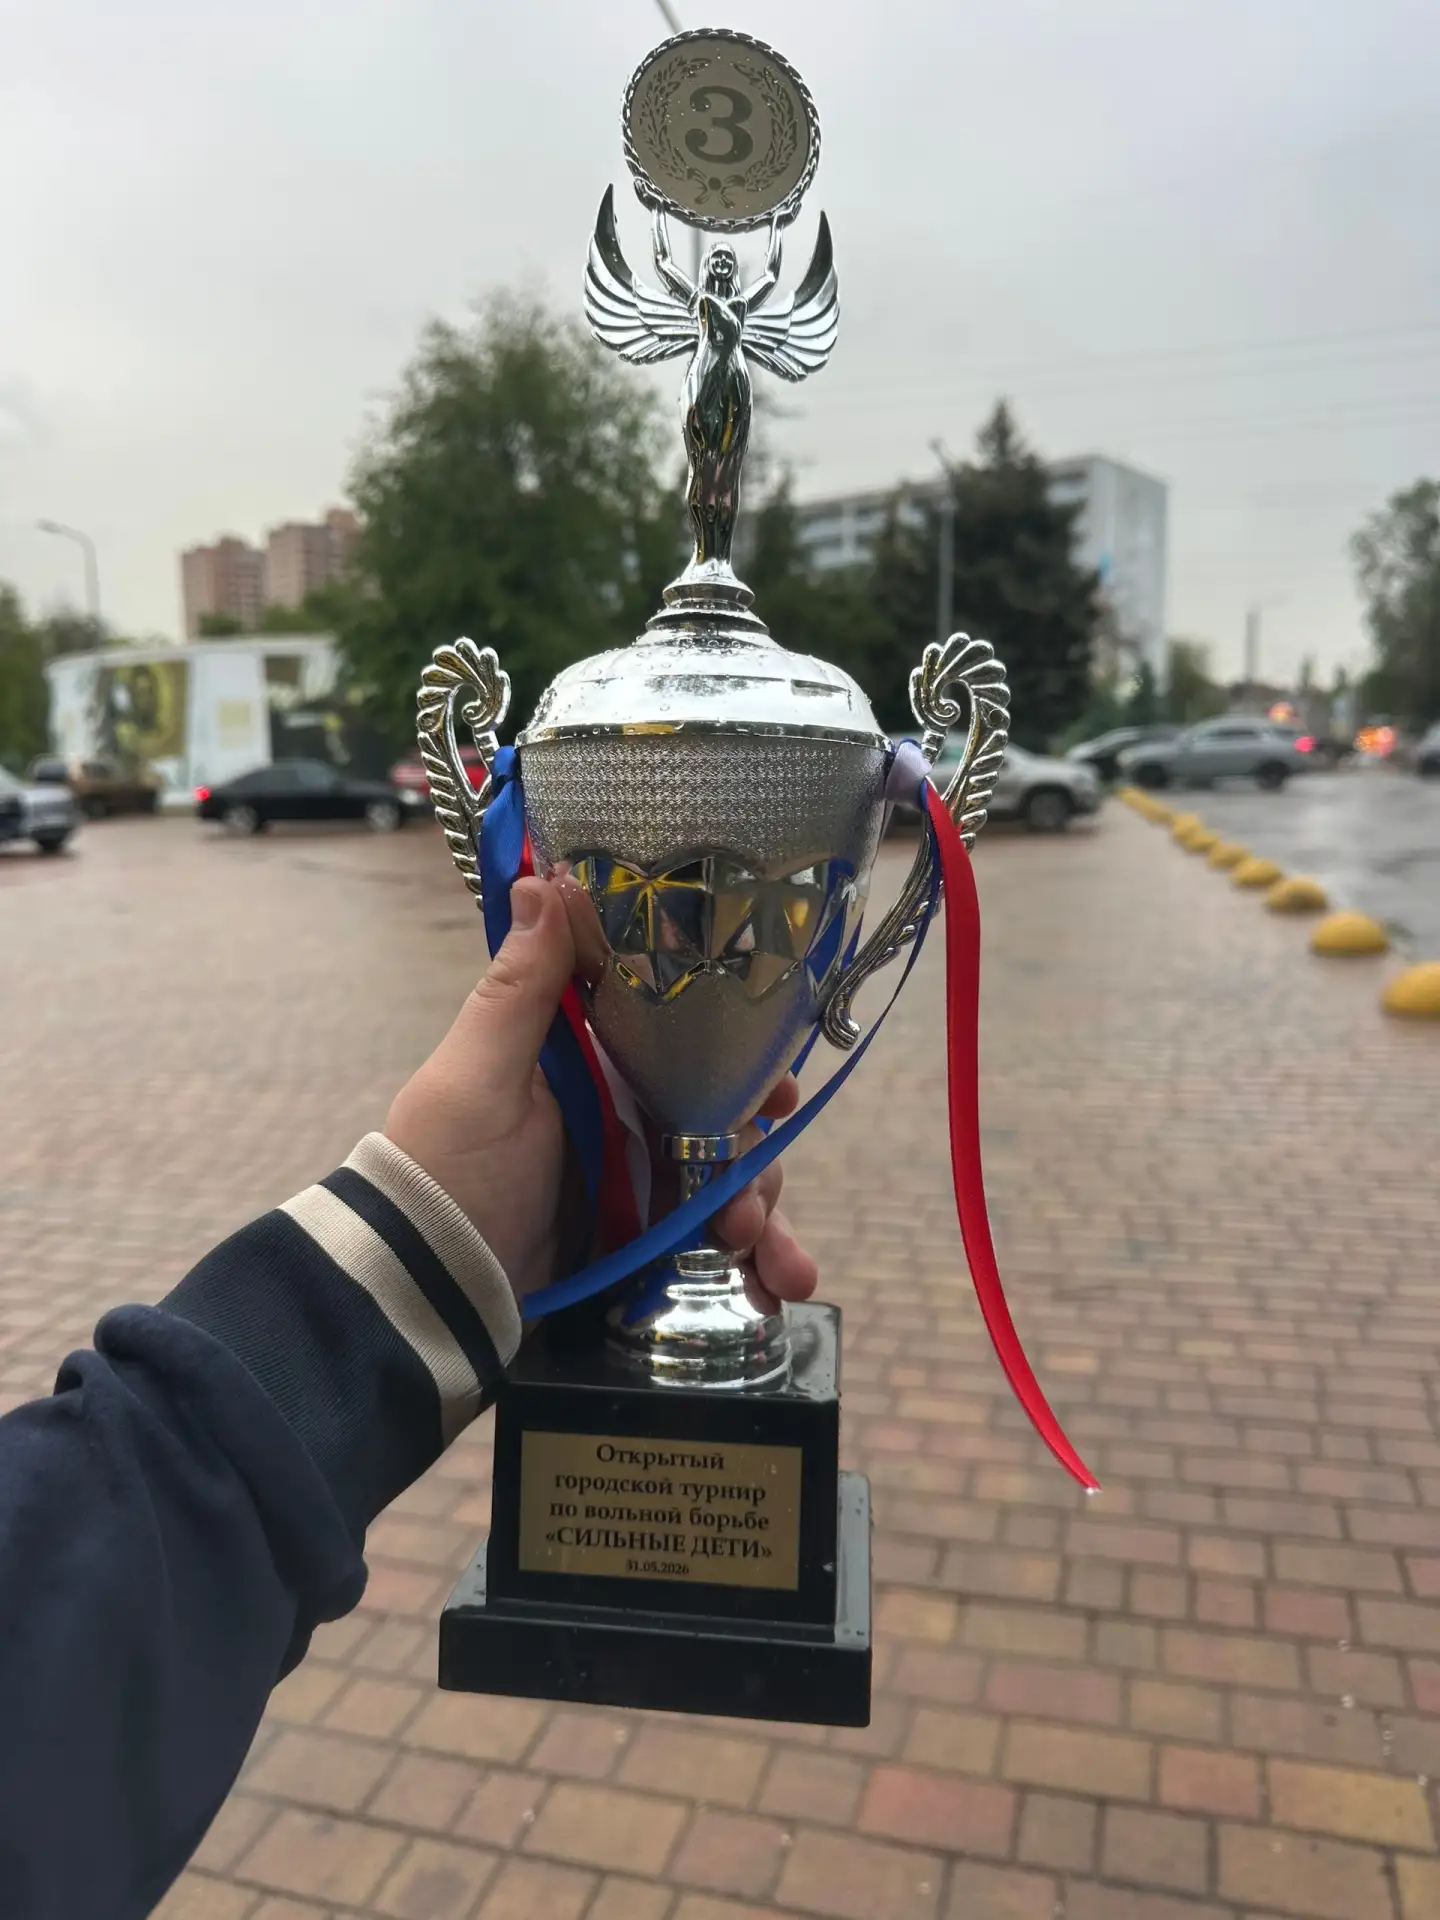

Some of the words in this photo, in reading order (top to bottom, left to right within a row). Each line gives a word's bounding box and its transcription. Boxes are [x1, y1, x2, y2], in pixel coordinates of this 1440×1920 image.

[685, 85, 753, 165] 3
[596, 1443, 724, 1471] Открытый
[555, 1474, 673, 1495] городской
[680, 1482, 766, 1506] турнир
[550, 1502, 577, 1517] по
[585, 1504, 681, 1526] вольной
[690, 1507, 769, 1532] борьбе
[546, 1527, 685, 1553] «СИЛЬНЫЕ
[691, 1534, 771, 1559] ДЕТИ»
